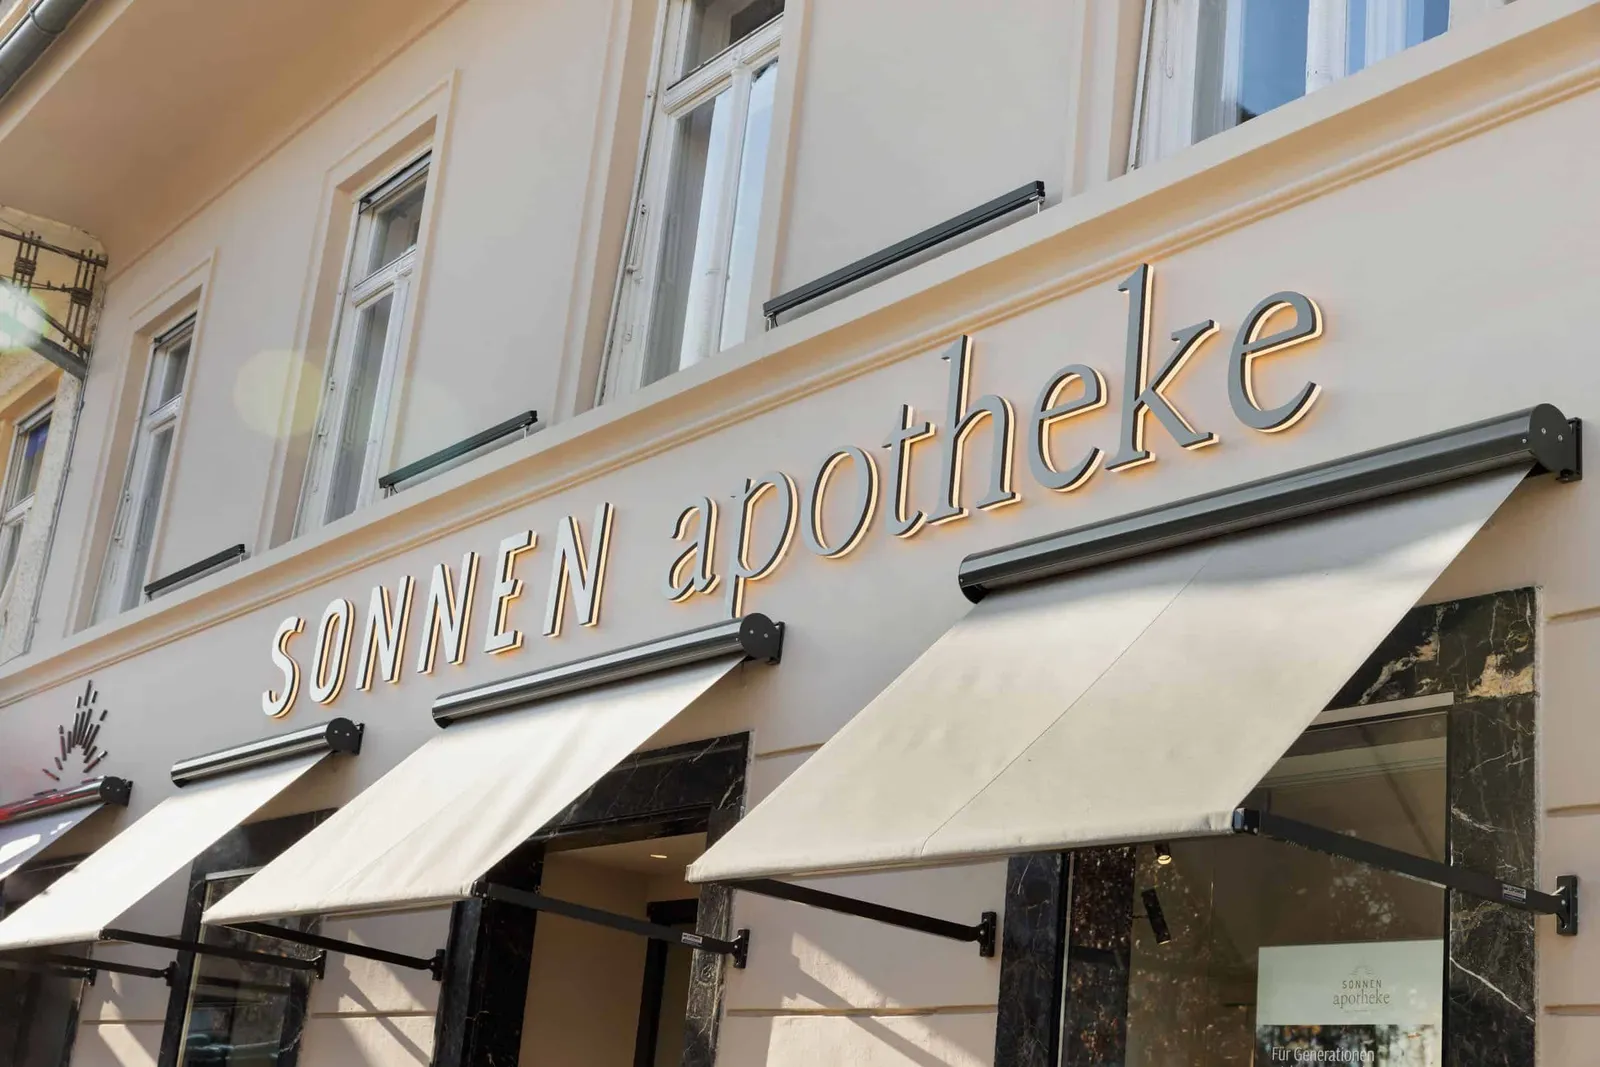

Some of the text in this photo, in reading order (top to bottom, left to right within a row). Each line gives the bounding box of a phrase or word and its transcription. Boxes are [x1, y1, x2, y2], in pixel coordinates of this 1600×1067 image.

[262, 262, 1324, 718] SONNEN apotheke
[1342, 979, 1382, 989] SONNEN
[1332, 988, 1390, 1009] apotheke
[1271, 1046, 1375, 1062] Für Generationen
